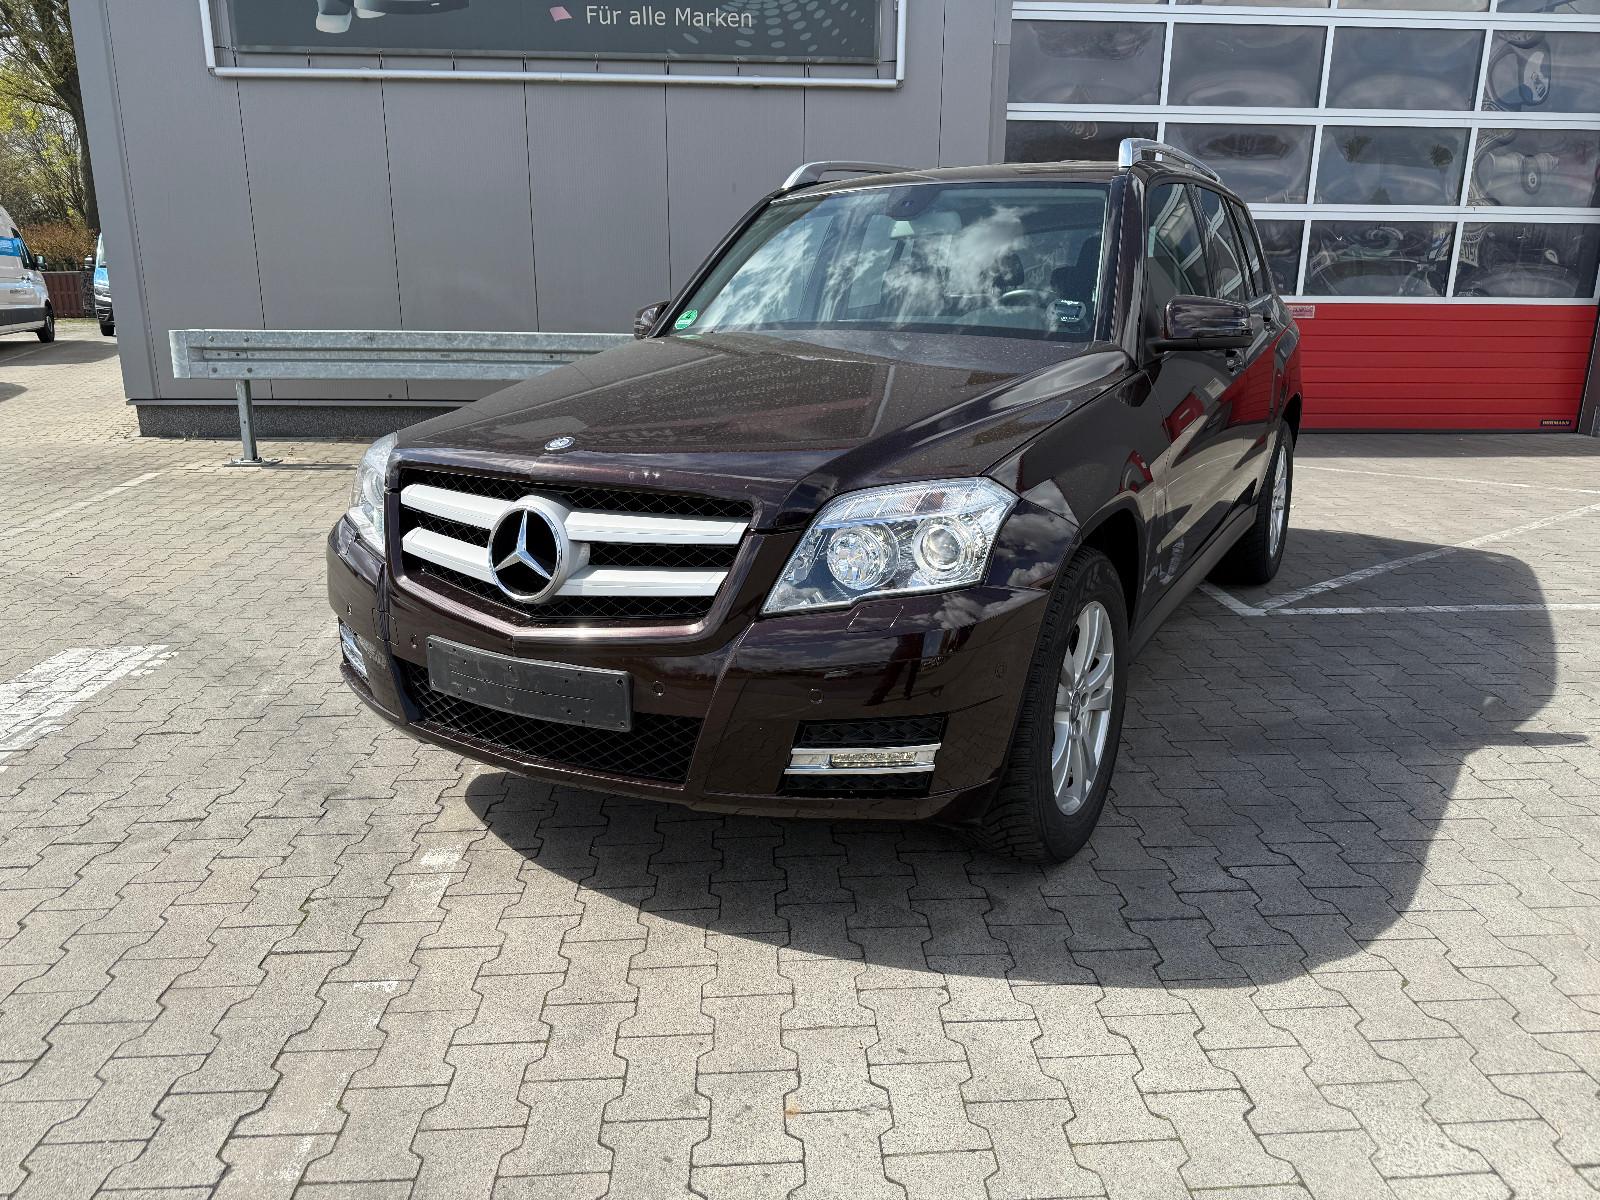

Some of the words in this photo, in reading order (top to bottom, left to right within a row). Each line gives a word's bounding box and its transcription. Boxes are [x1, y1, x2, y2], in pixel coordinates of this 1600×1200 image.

[586, 5, 621, 25] Für
[629, 5, 666, 26] alle
[675, 7, 752, 27] Marken
